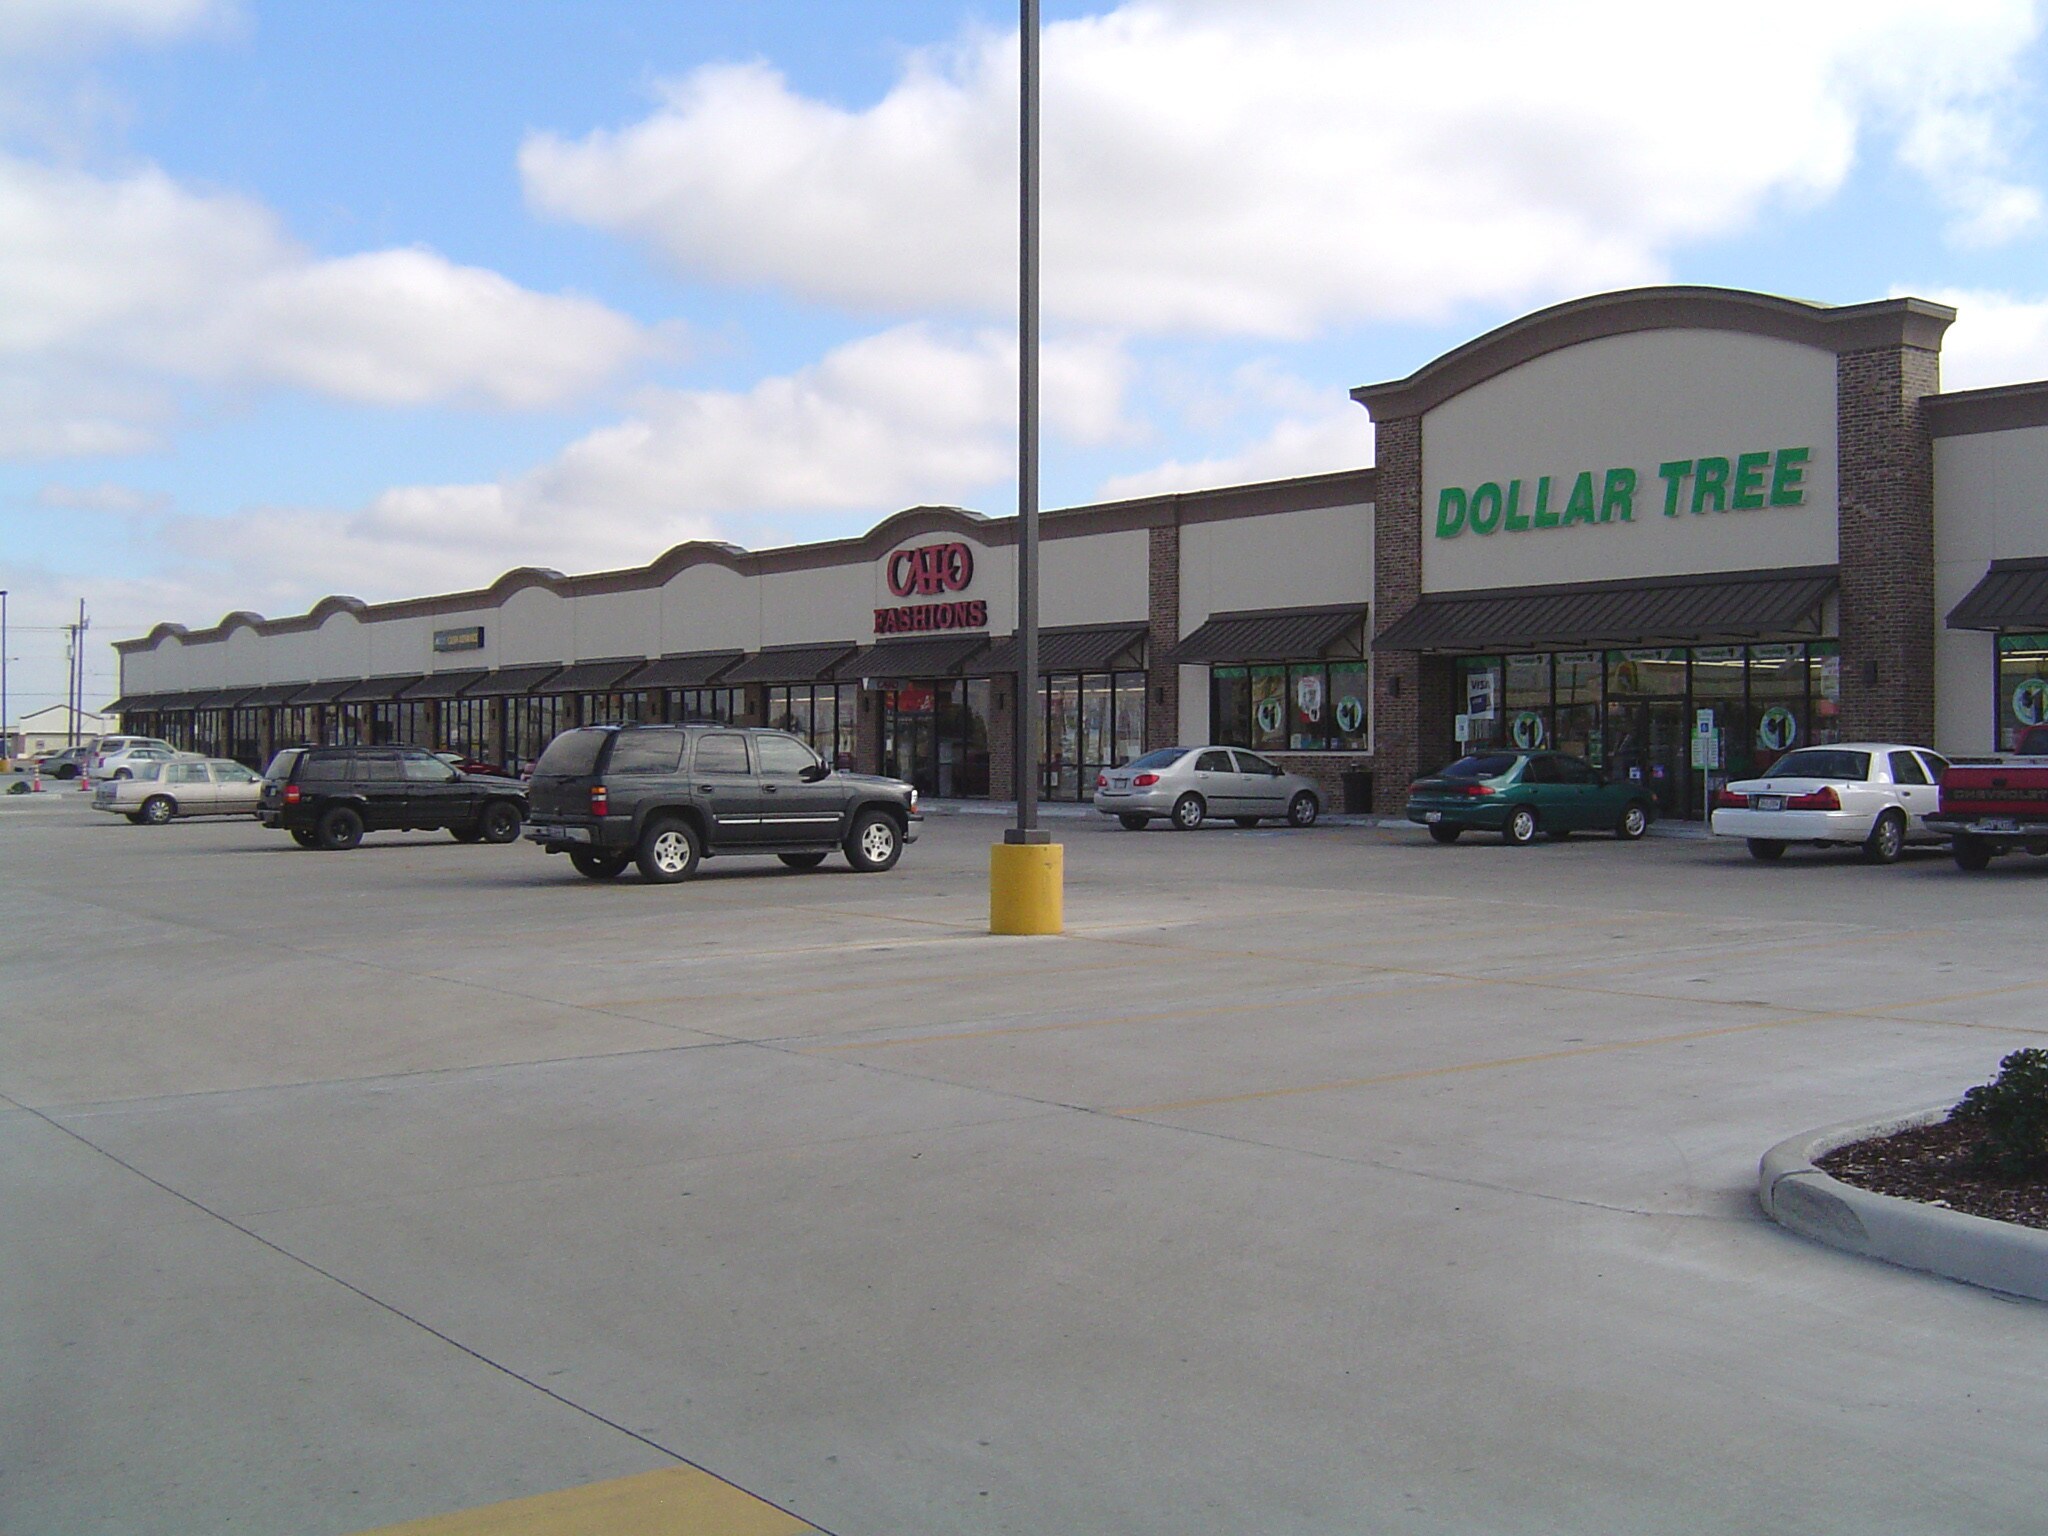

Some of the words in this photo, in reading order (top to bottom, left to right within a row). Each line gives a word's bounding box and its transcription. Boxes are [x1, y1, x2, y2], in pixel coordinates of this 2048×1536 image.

[1435, 467, 1637, 539] DOLLAR
[1659, 446, 1810, 518] TREE
[887, 542, 974, 597] CATO
[873, 600, 988, 634] FASHIONS
